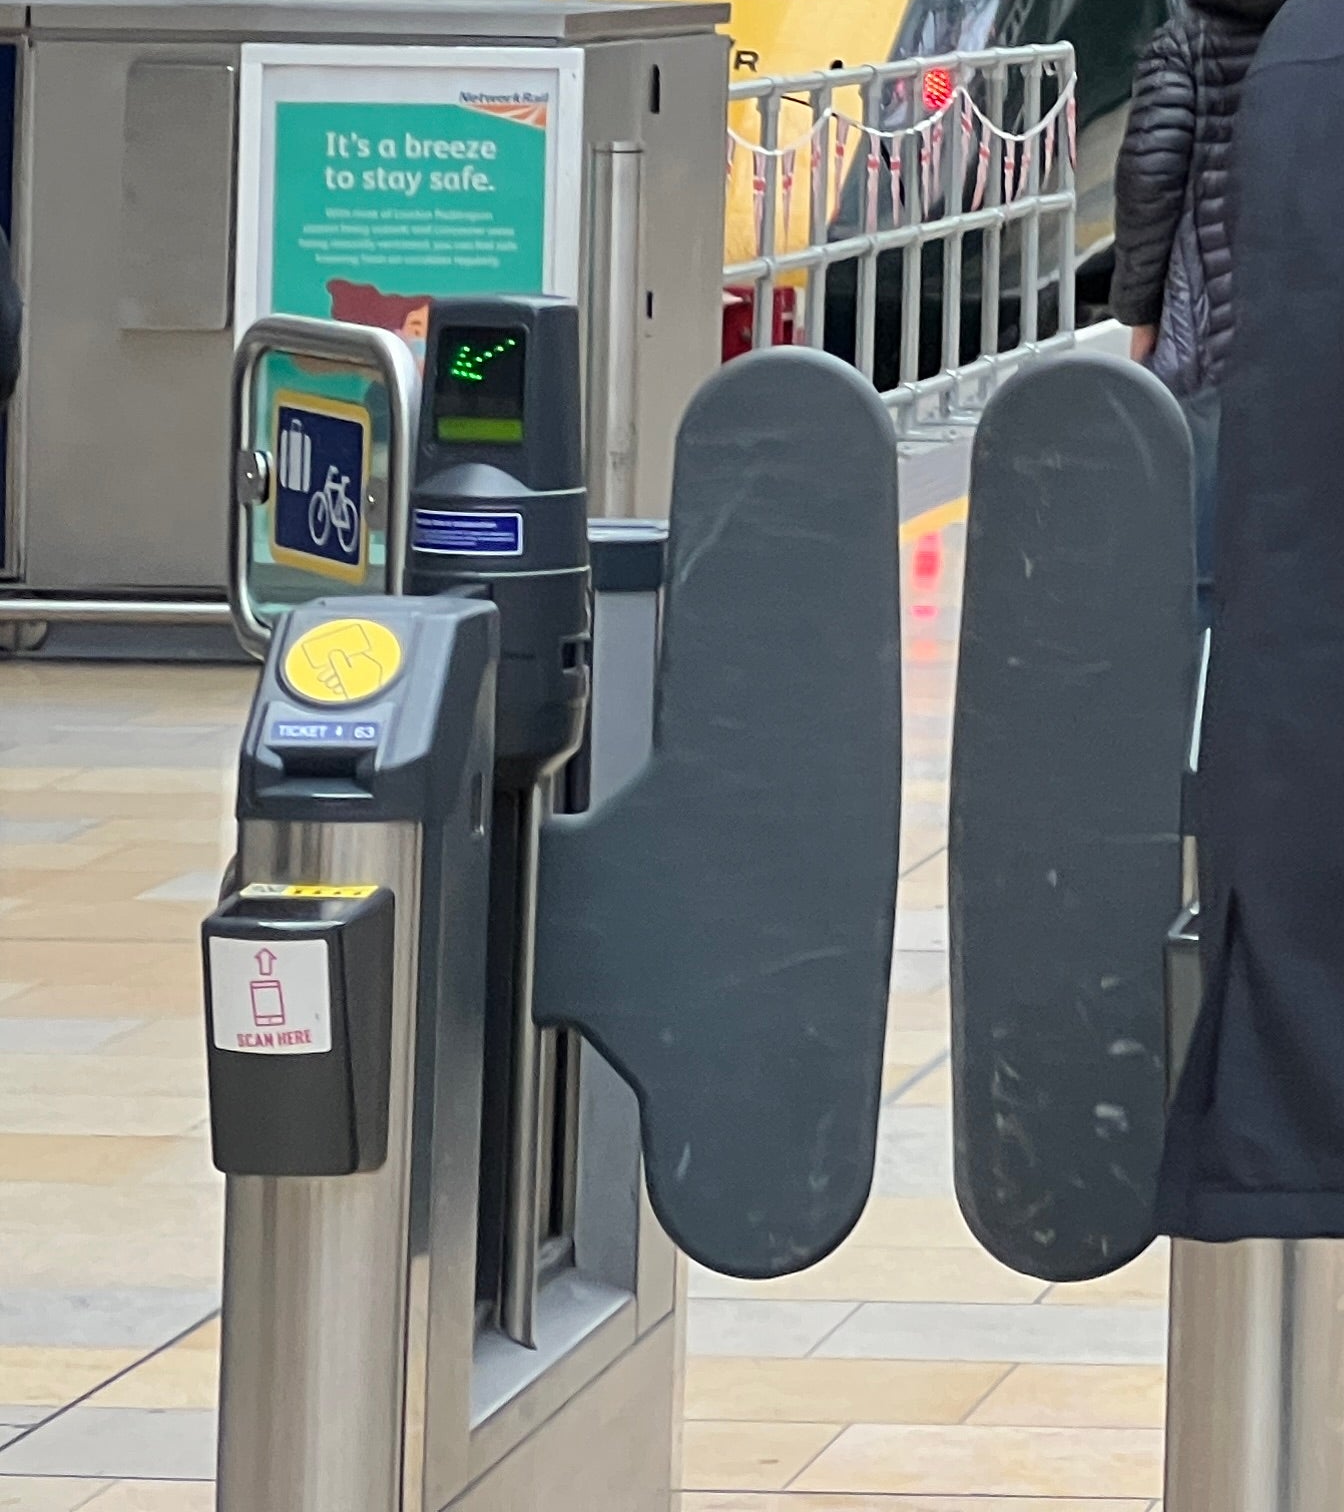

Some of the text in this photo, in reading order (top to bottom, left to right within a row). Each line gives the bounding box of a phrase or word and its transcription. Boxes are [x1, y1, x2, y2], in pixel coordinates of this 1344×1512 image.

[326, 132, 497, 160] It's a breeze
[326, 165, 496, 197] to stay safe.
[278, 725, 328, 738] TICKET
[236, 1029, 312, 1049] SCAN HERE
